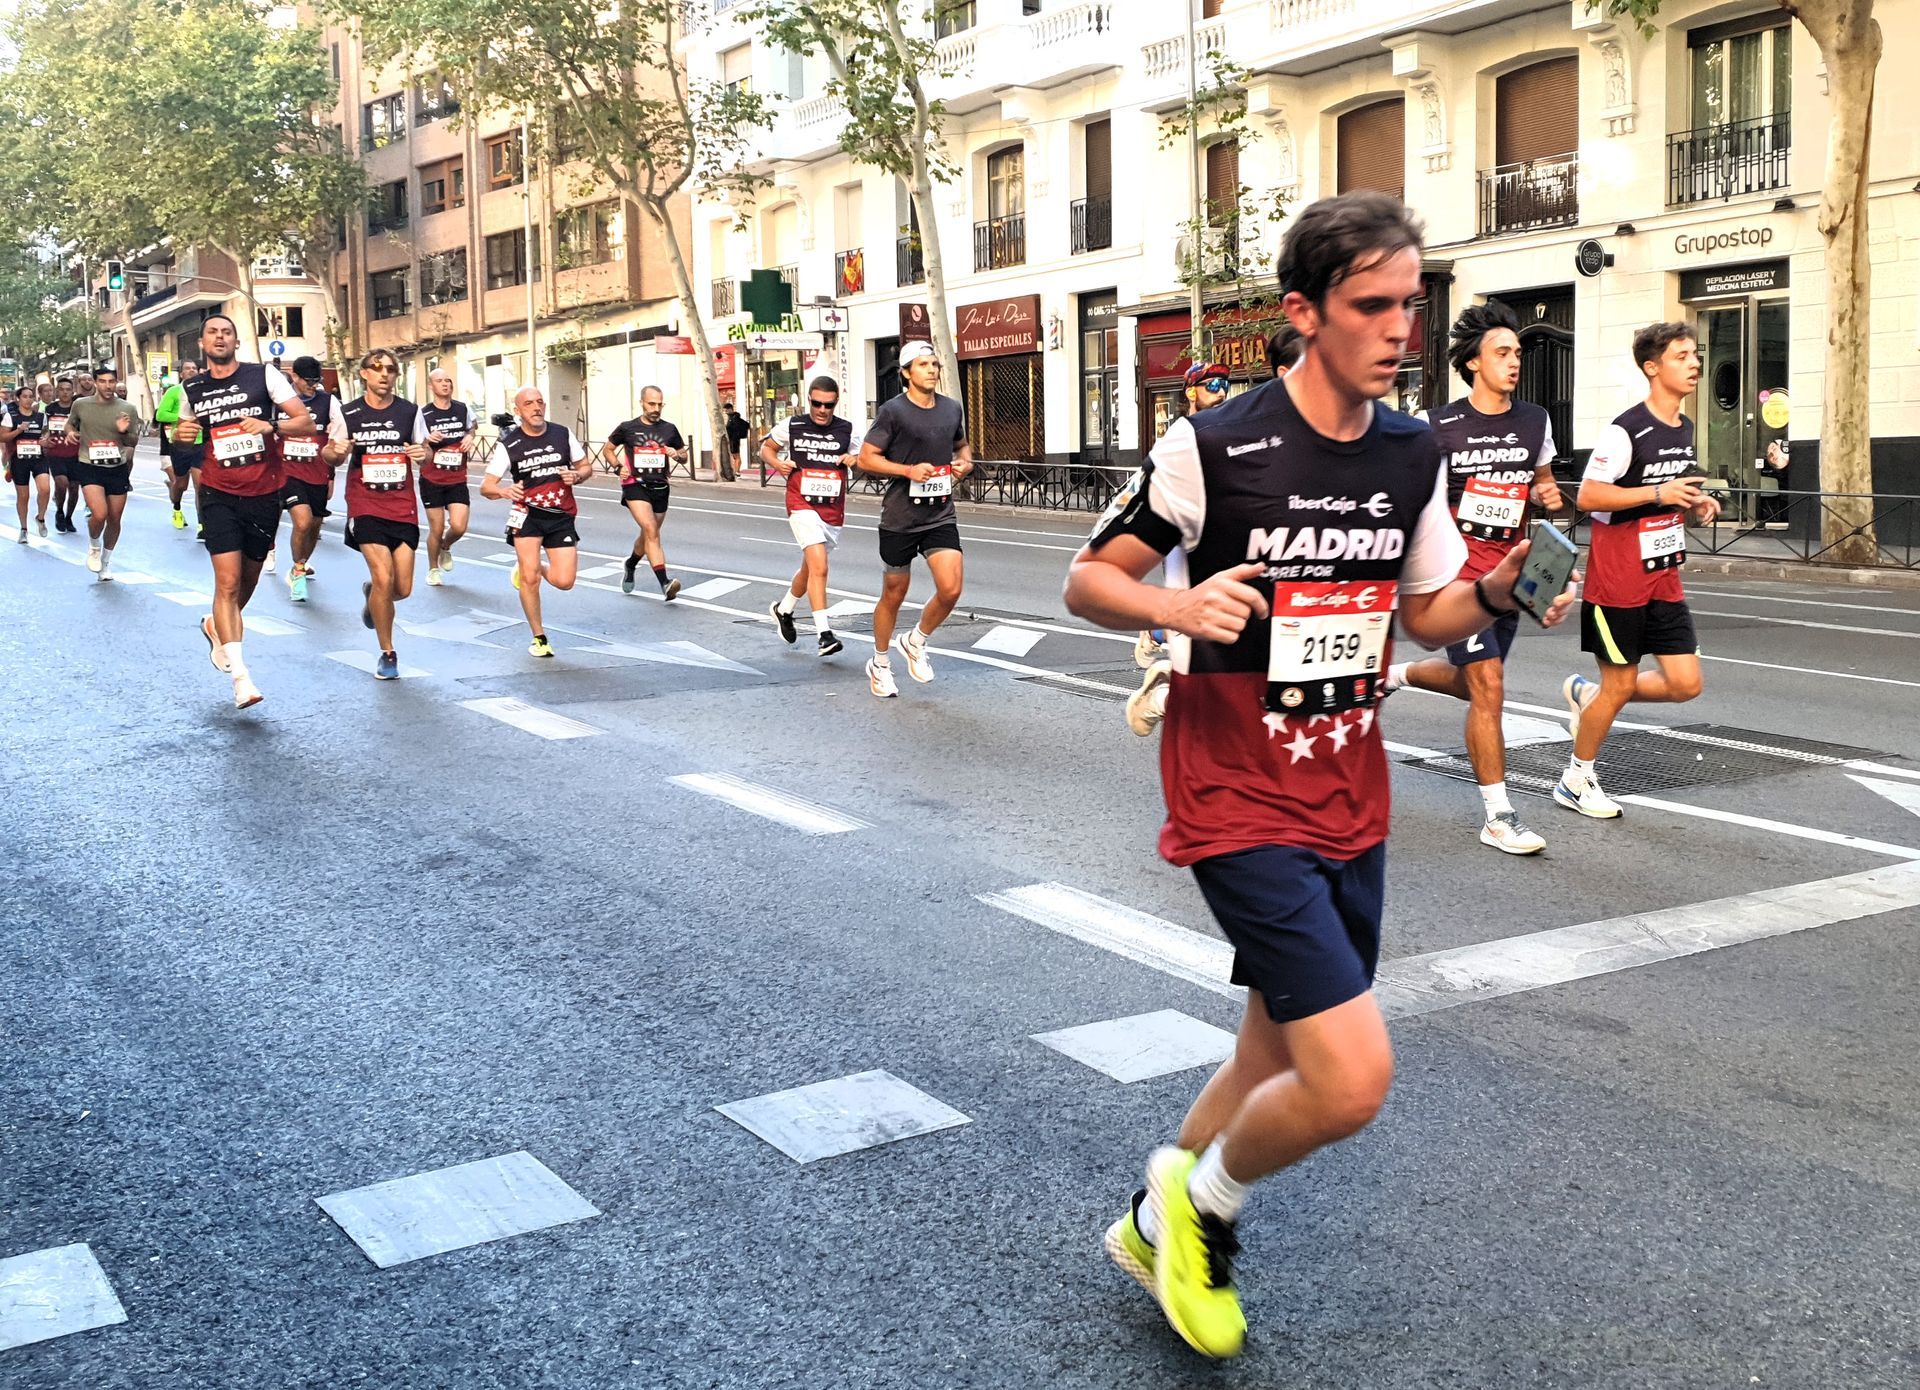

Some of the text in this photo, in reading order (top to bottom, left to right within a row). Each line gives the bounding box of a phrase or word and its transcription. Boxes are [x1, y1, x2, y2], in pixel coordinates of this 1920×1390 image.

[1675, 227, 1772, 254] Grupostop
[1583, 248, 1601, 258] Grupo
[1585, 257, 1599, 266] stop
[1770, 270, 1776, 278] Y
[1707, 282, 1740, 292] MEDICINA
[1536, 303, 1546, 319] 17
[962, 308, 984, 334] José
[964, 332, 1033, 352] TALLAS ESPECIALES
[1212, 339, 1266, 365] VIENA
[193, 393, 248, 413] MADRID
[209, 406, 263, 424] MADRID
[430, 421, 462, 432] MADRID
[353, 430, 400, 441] MADRID
[225, 439, 253, 453] 3019
[291, 446, 309, 454] 2185
[366, 445, 406, 454] MADR
[793, 439, 841, 450] MADRID
[517, 453, 562, 469] MADRID
[1451, 448, 1529, 466] MADRID
[373, 469, 398, 479] 3035
[1475, 470, 1535, 485] MADRD
[810, 484, 833, 492] 2250
[921, 482, 944, 492] 1789
[1475, 504, 1510, 520] 9340
[1246, 527, 1405, 561] MADRID
[1653, 534, 1677, 550] 9339
[1259, 564, 1335, 581] ORRE POR
[1302, 633, 1361, 665] 2159
